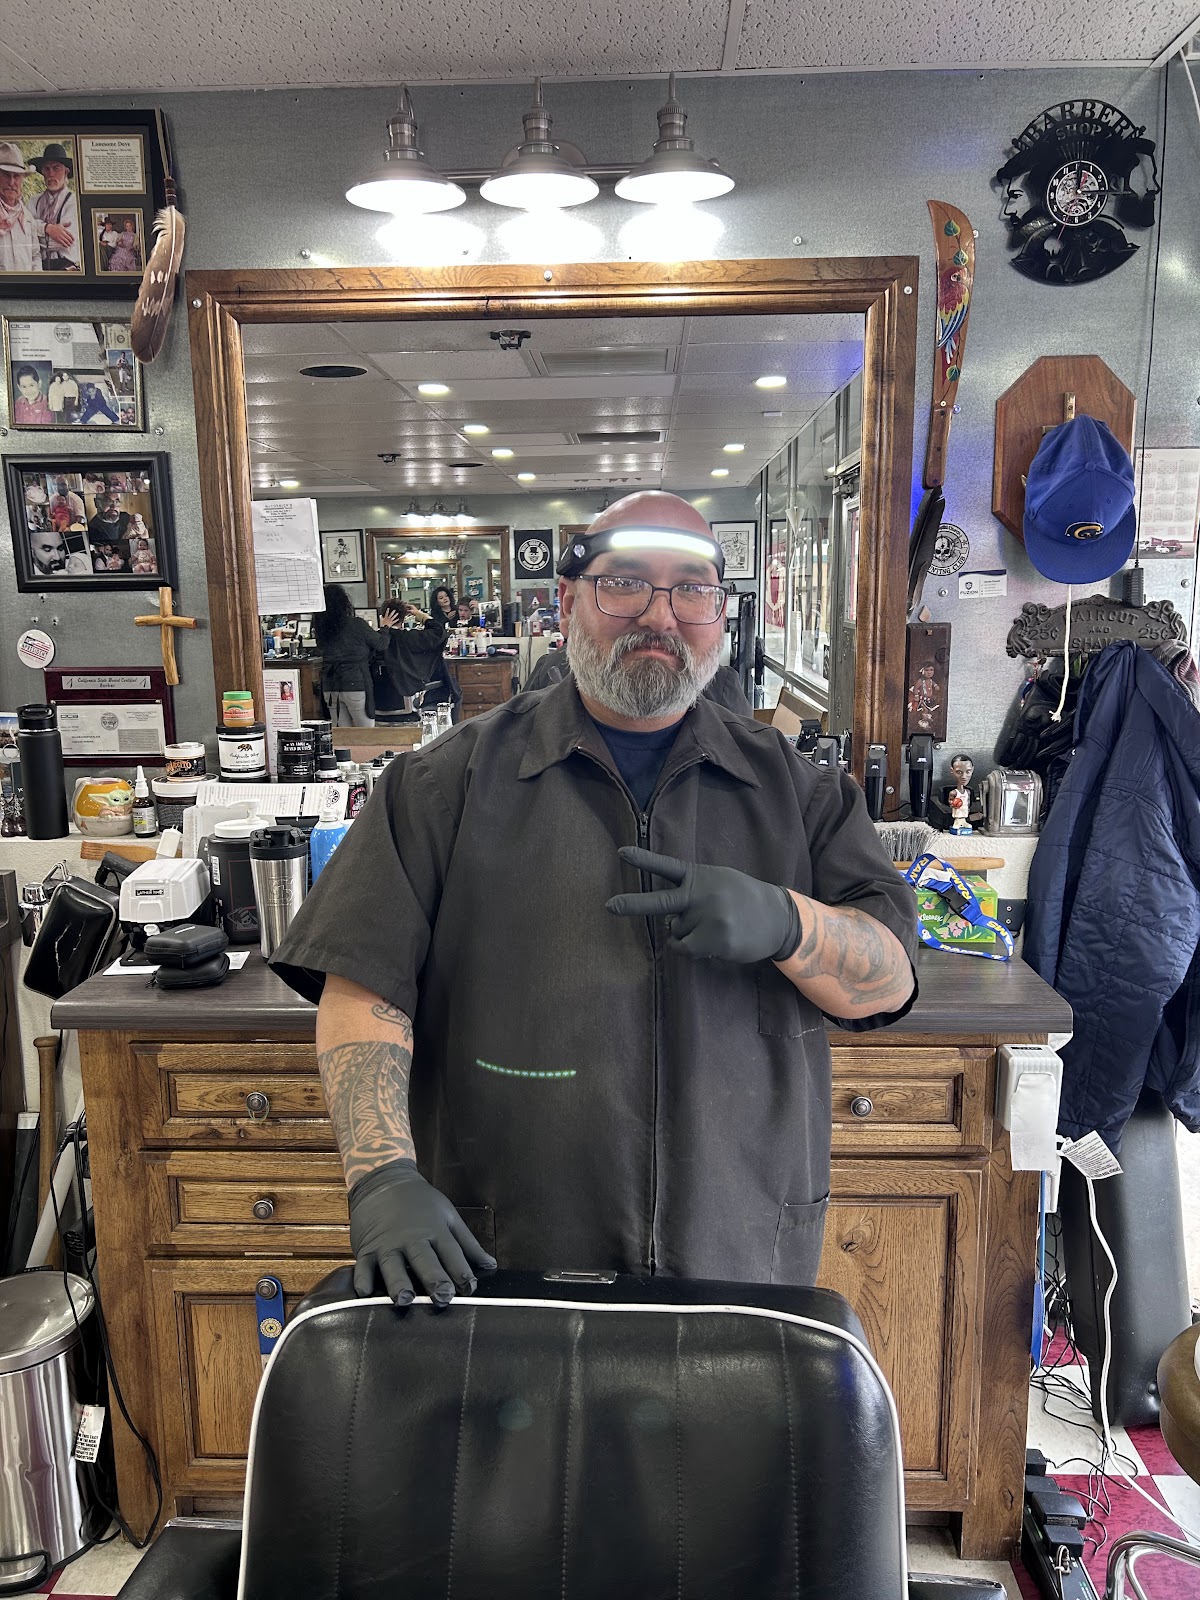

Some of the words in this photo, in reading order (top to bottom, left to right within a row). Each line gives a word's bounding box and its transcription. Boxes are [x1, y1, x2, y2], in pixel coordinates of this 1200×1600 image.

[1055, 122, 1102, 140] SHOP
[952, 556, 966, 571] CLUB
[1089, 626, 1111, 634] AND
[946, 867, 972, 900] RAMS
